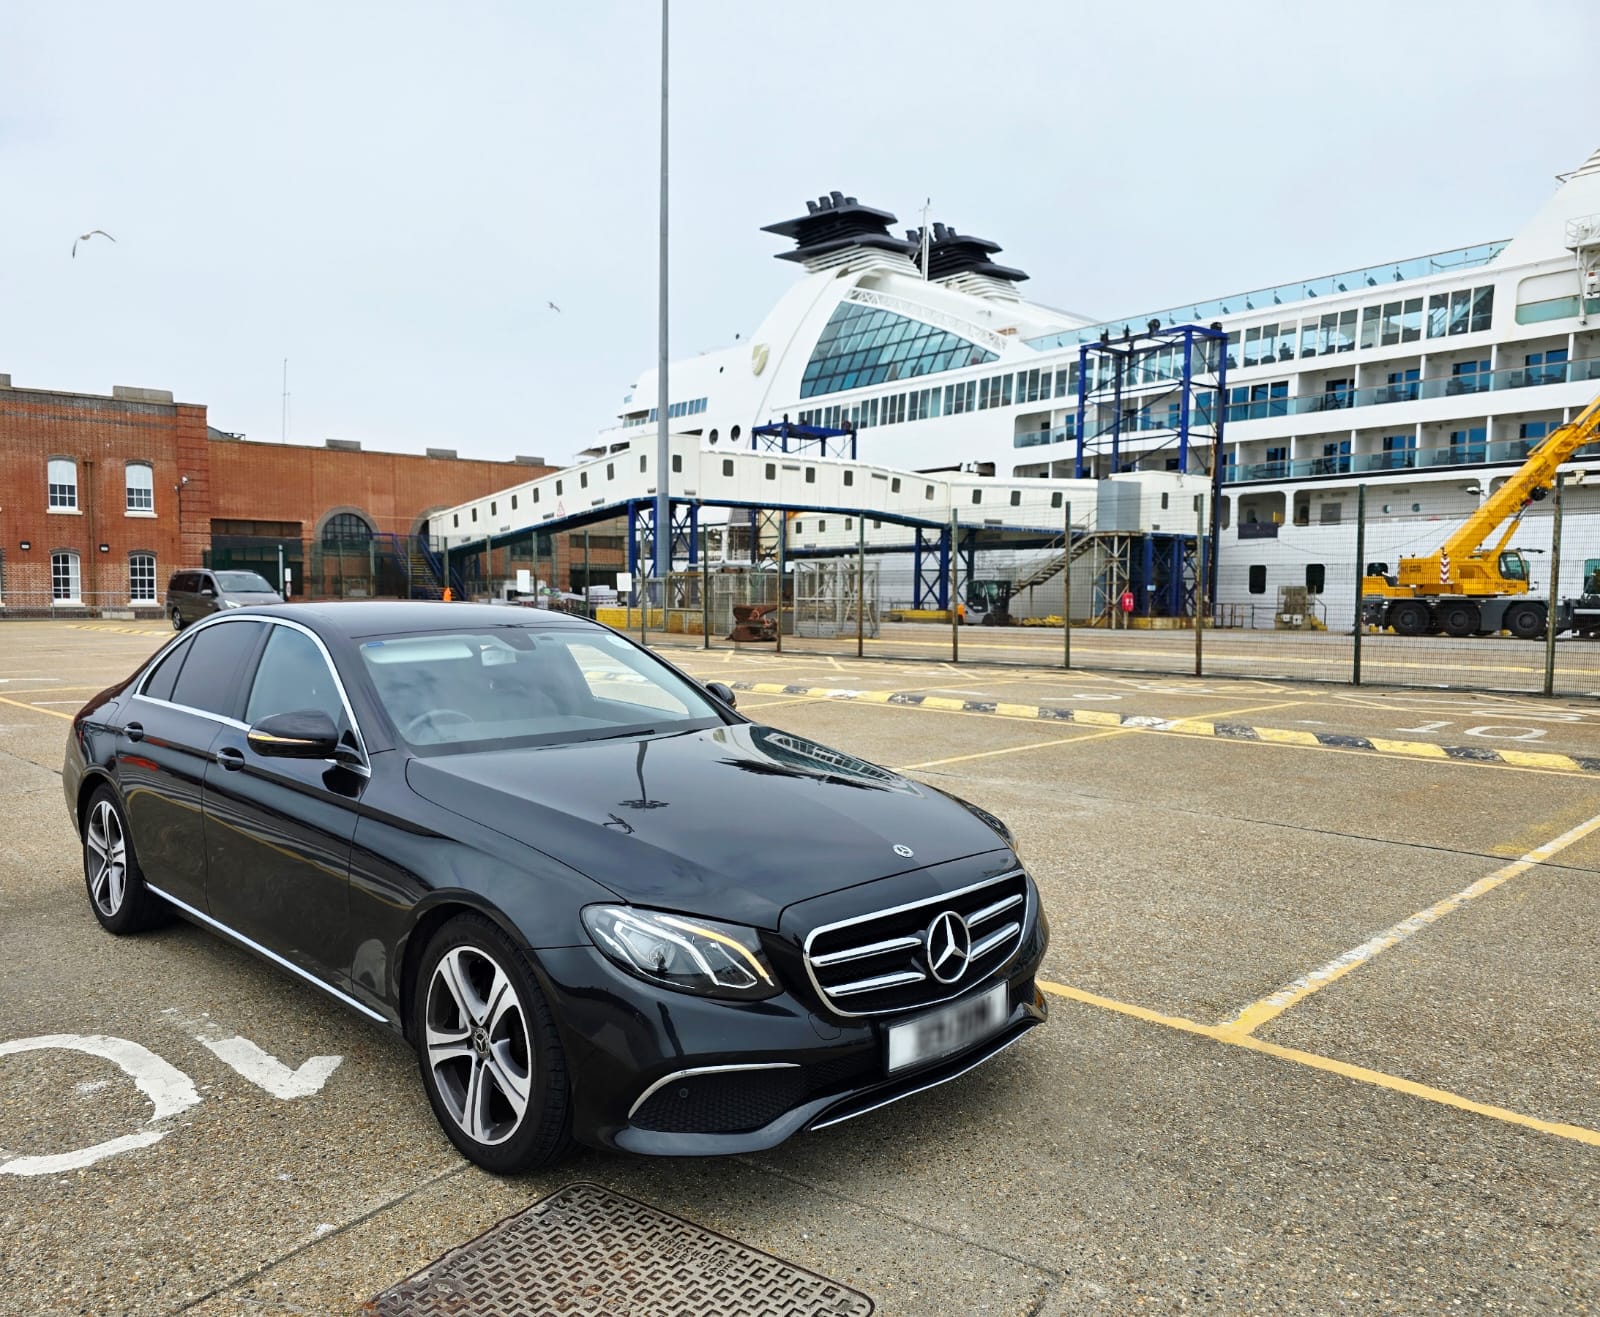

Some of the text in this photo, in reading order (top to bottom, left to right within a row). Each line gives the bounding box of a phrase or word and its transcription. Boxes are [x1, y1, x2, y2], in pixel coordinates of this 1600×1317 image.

[650, 1241, 697, 1264] DUDLEY
[658, 1235, 733, 1272] BRICKHOUSE
[587, 1283, 661, 1317] DUCTIL
